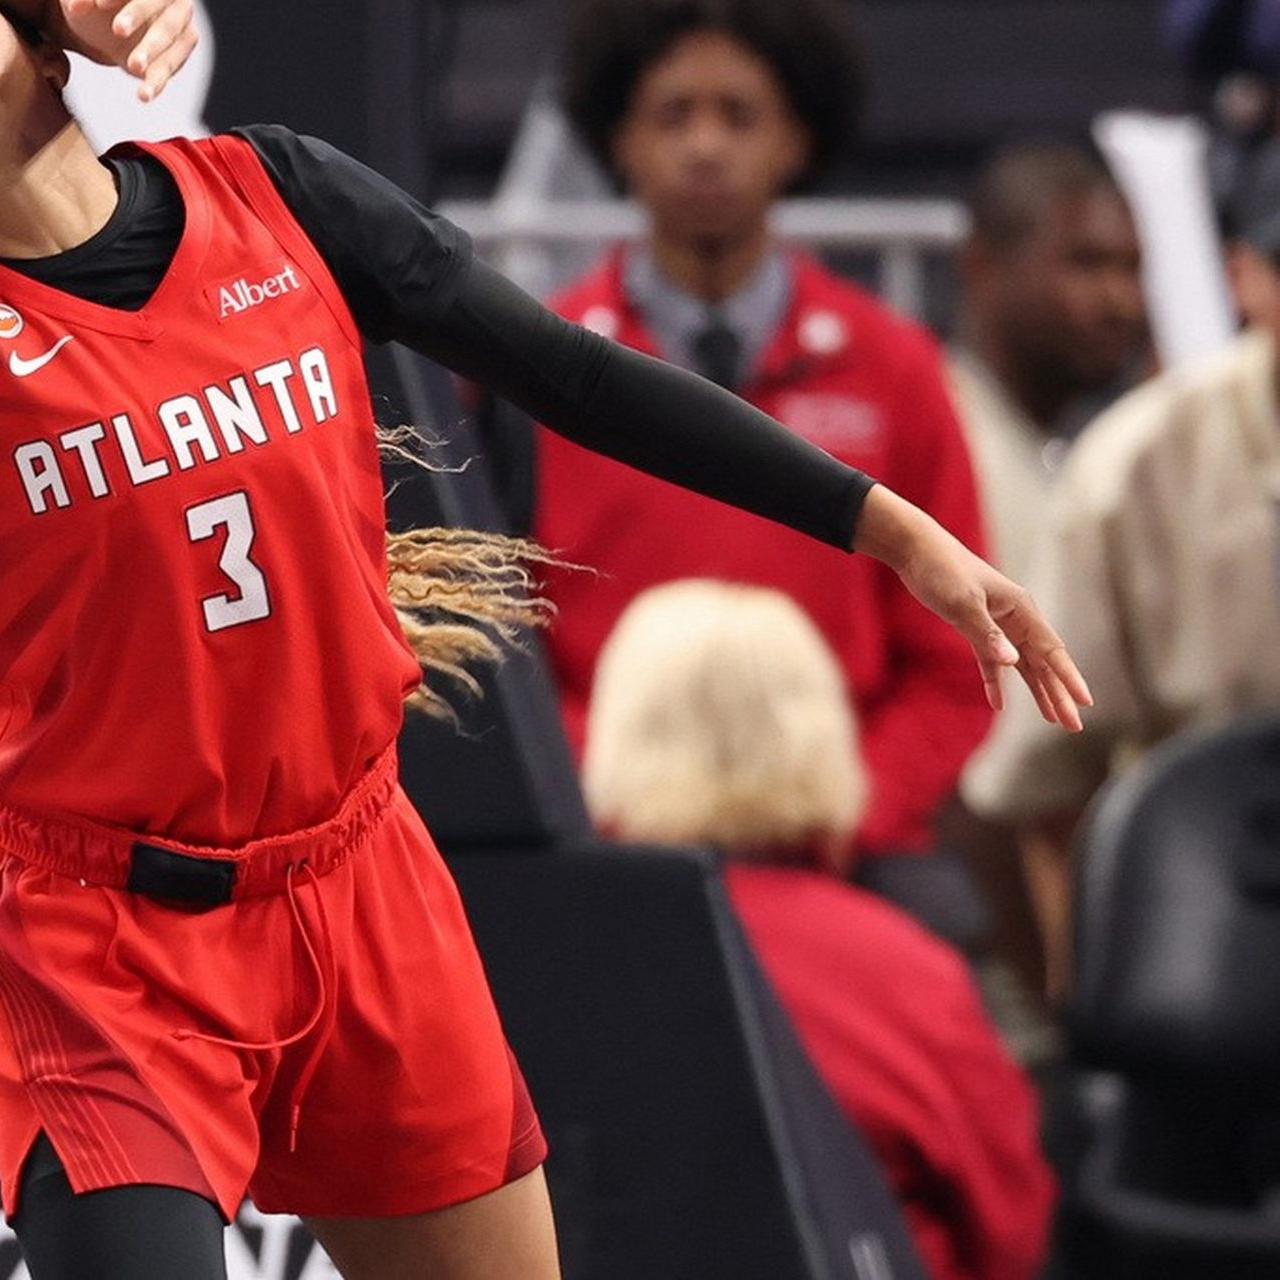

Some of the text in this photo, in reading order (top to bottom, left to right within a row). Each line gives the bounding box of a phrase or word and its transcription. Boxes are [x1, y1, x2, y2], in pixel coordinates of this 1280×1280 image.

[217, 263, 301, 318] Albert
[12, 345, 339, 516] ATLANTA
[184, 488, 271, 634] 3
